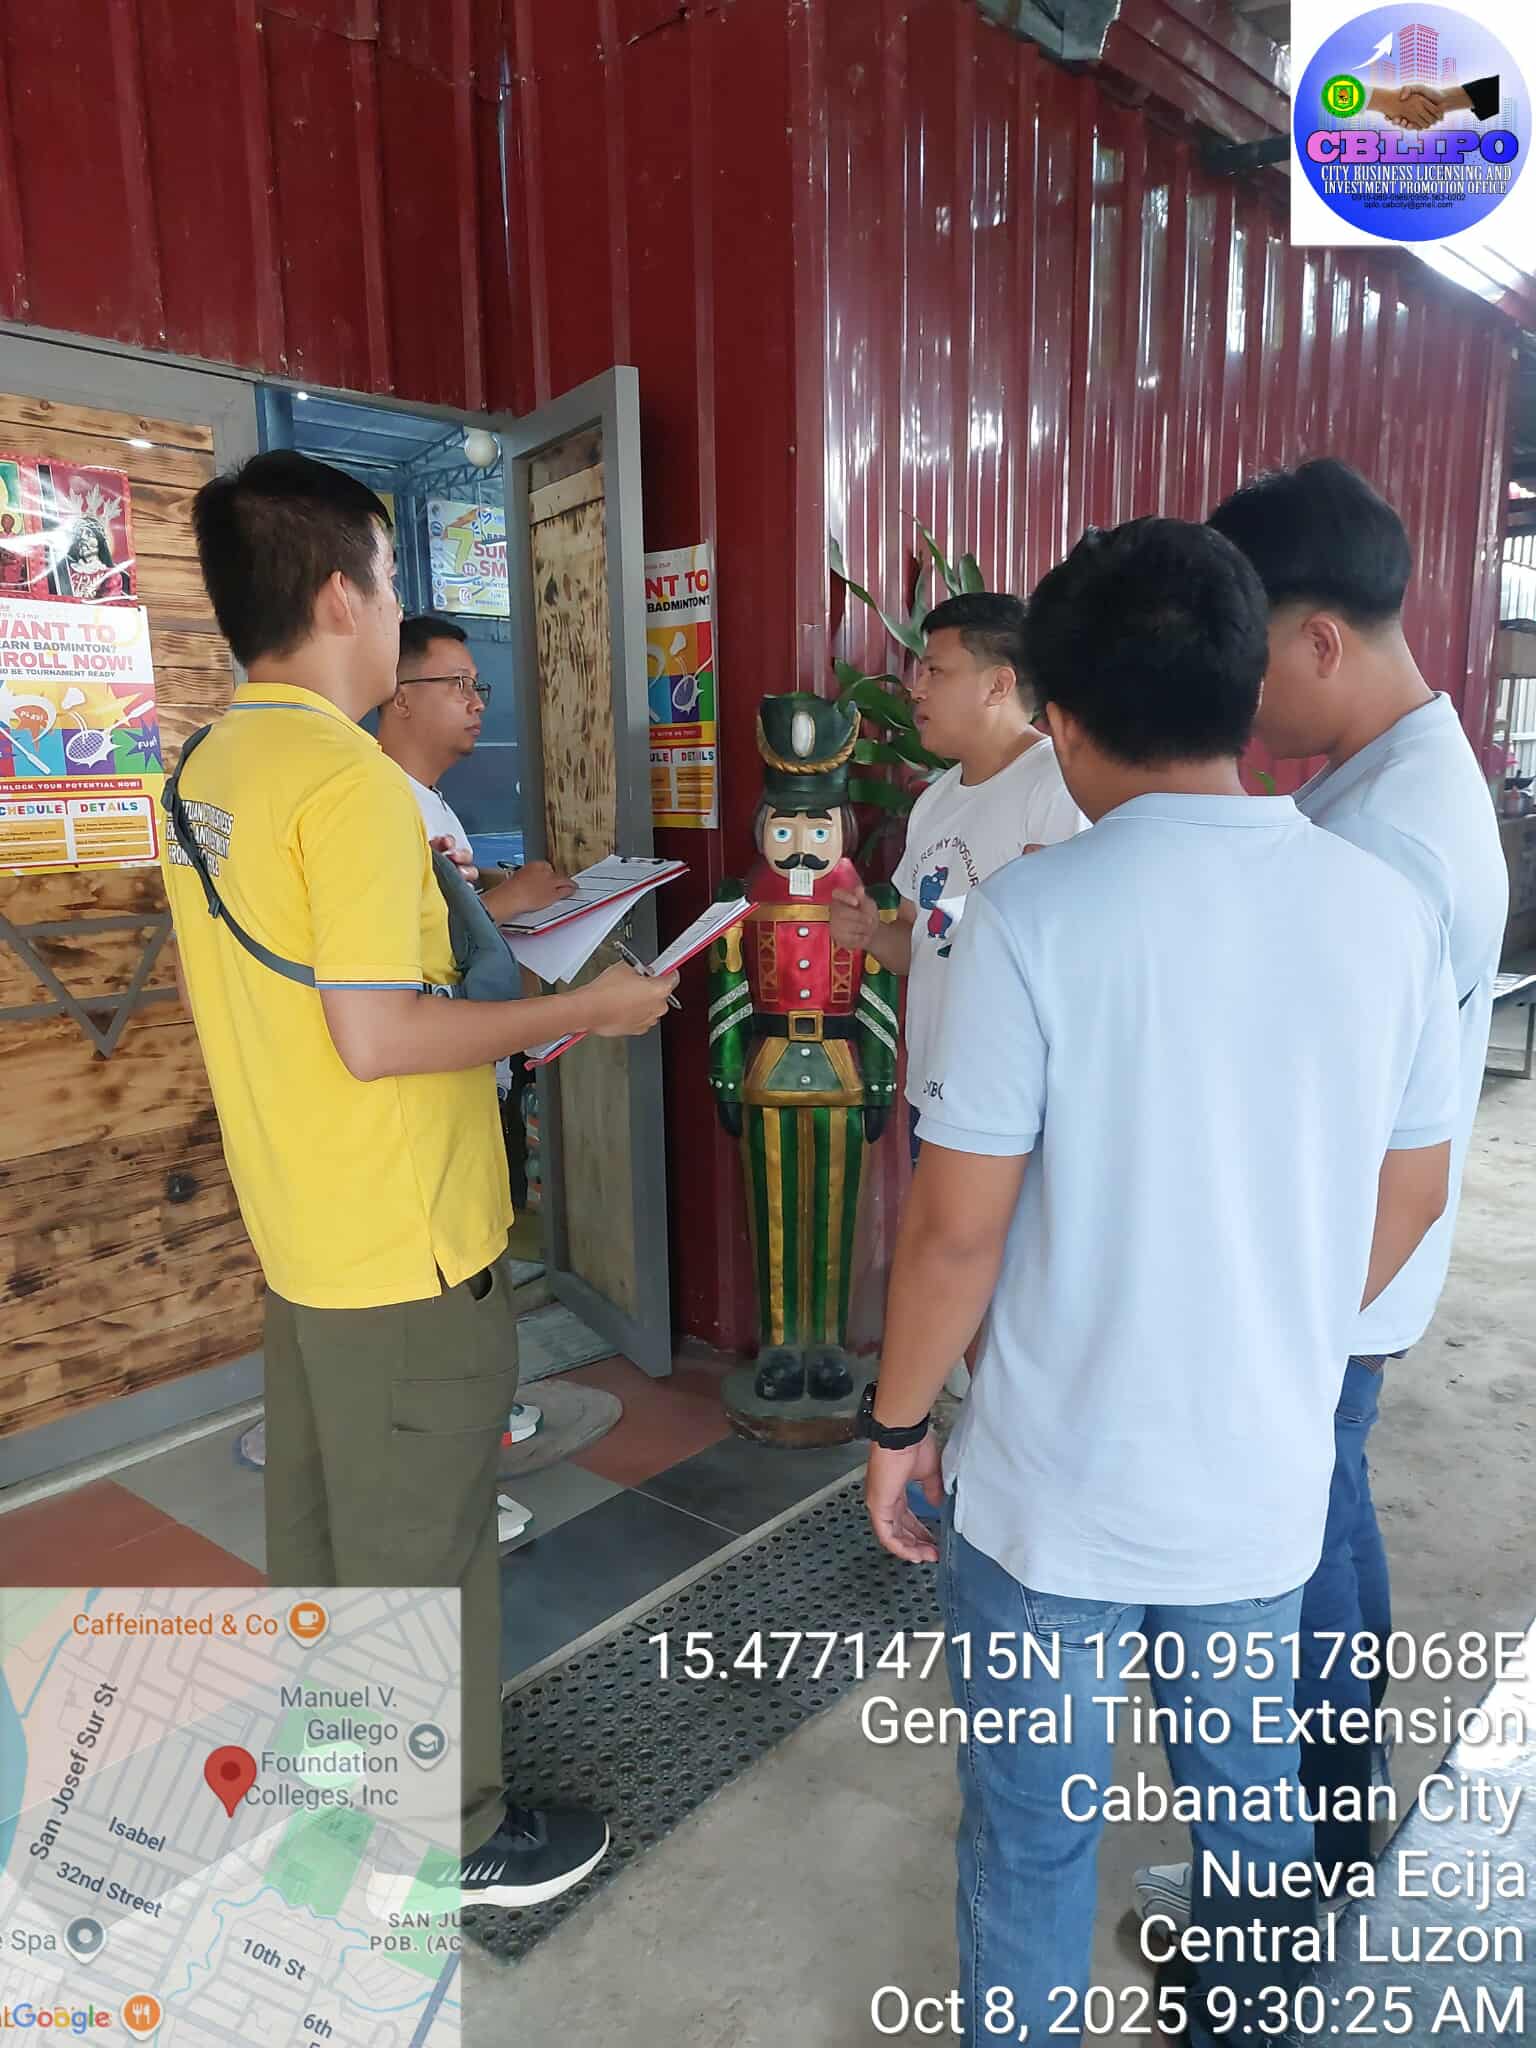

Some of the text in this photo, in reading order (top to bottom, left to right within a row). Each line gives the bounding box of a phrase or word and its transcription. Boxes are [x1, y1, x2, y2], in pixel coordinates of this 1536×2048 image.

[684, 568, 709, 594] TO
[78, 623, 116, 643] TO
[34, 641, 117, 653] BADMINTON?
[73, 653, 134, 671] NOW!
[26, 669, 85, 678] TOURNAMENT
[88, 671, 116, 679] READY
[37, 783, 63, 791] YOUR
[66, 782, 115, 790] POTENTIAL
[80, 801, 139, 813] DETAILS
